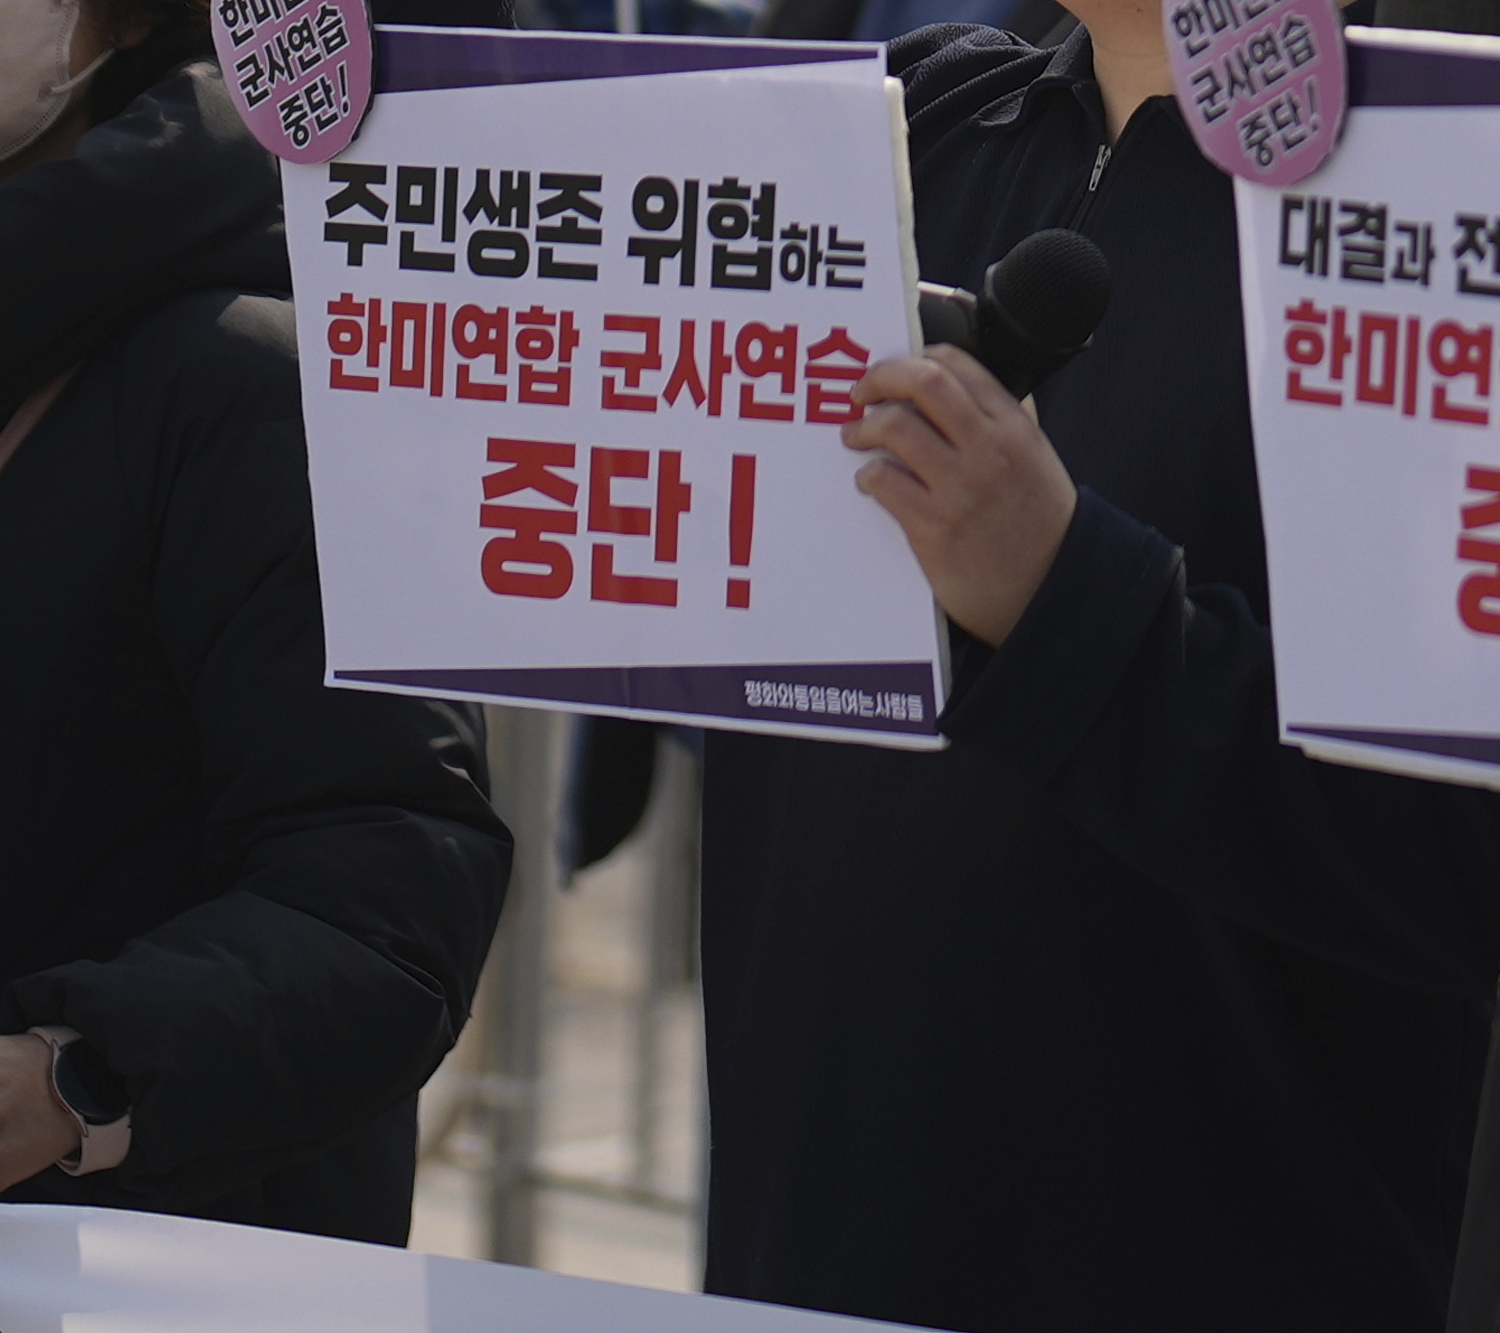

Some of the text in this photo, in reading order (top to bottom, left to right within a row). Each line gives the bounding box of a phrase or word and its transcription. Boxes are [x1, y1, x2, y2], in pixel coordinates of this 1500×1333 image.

[234, 1, 350, 110] 군사연습
[277, 61, 350, 148] 중단!
[1190, 10, 1317, 124] 군사연습
[1240, 76, 1320, 168] 중단!
[322, 162, 867, 291] 주민생존 위협하는
[1278, 194, 1437, 289] 대결과
[326, 292, 871, 425] 한미연합 군사연습
[744, 680, 924, 723] 평화와통일을여는사람들
